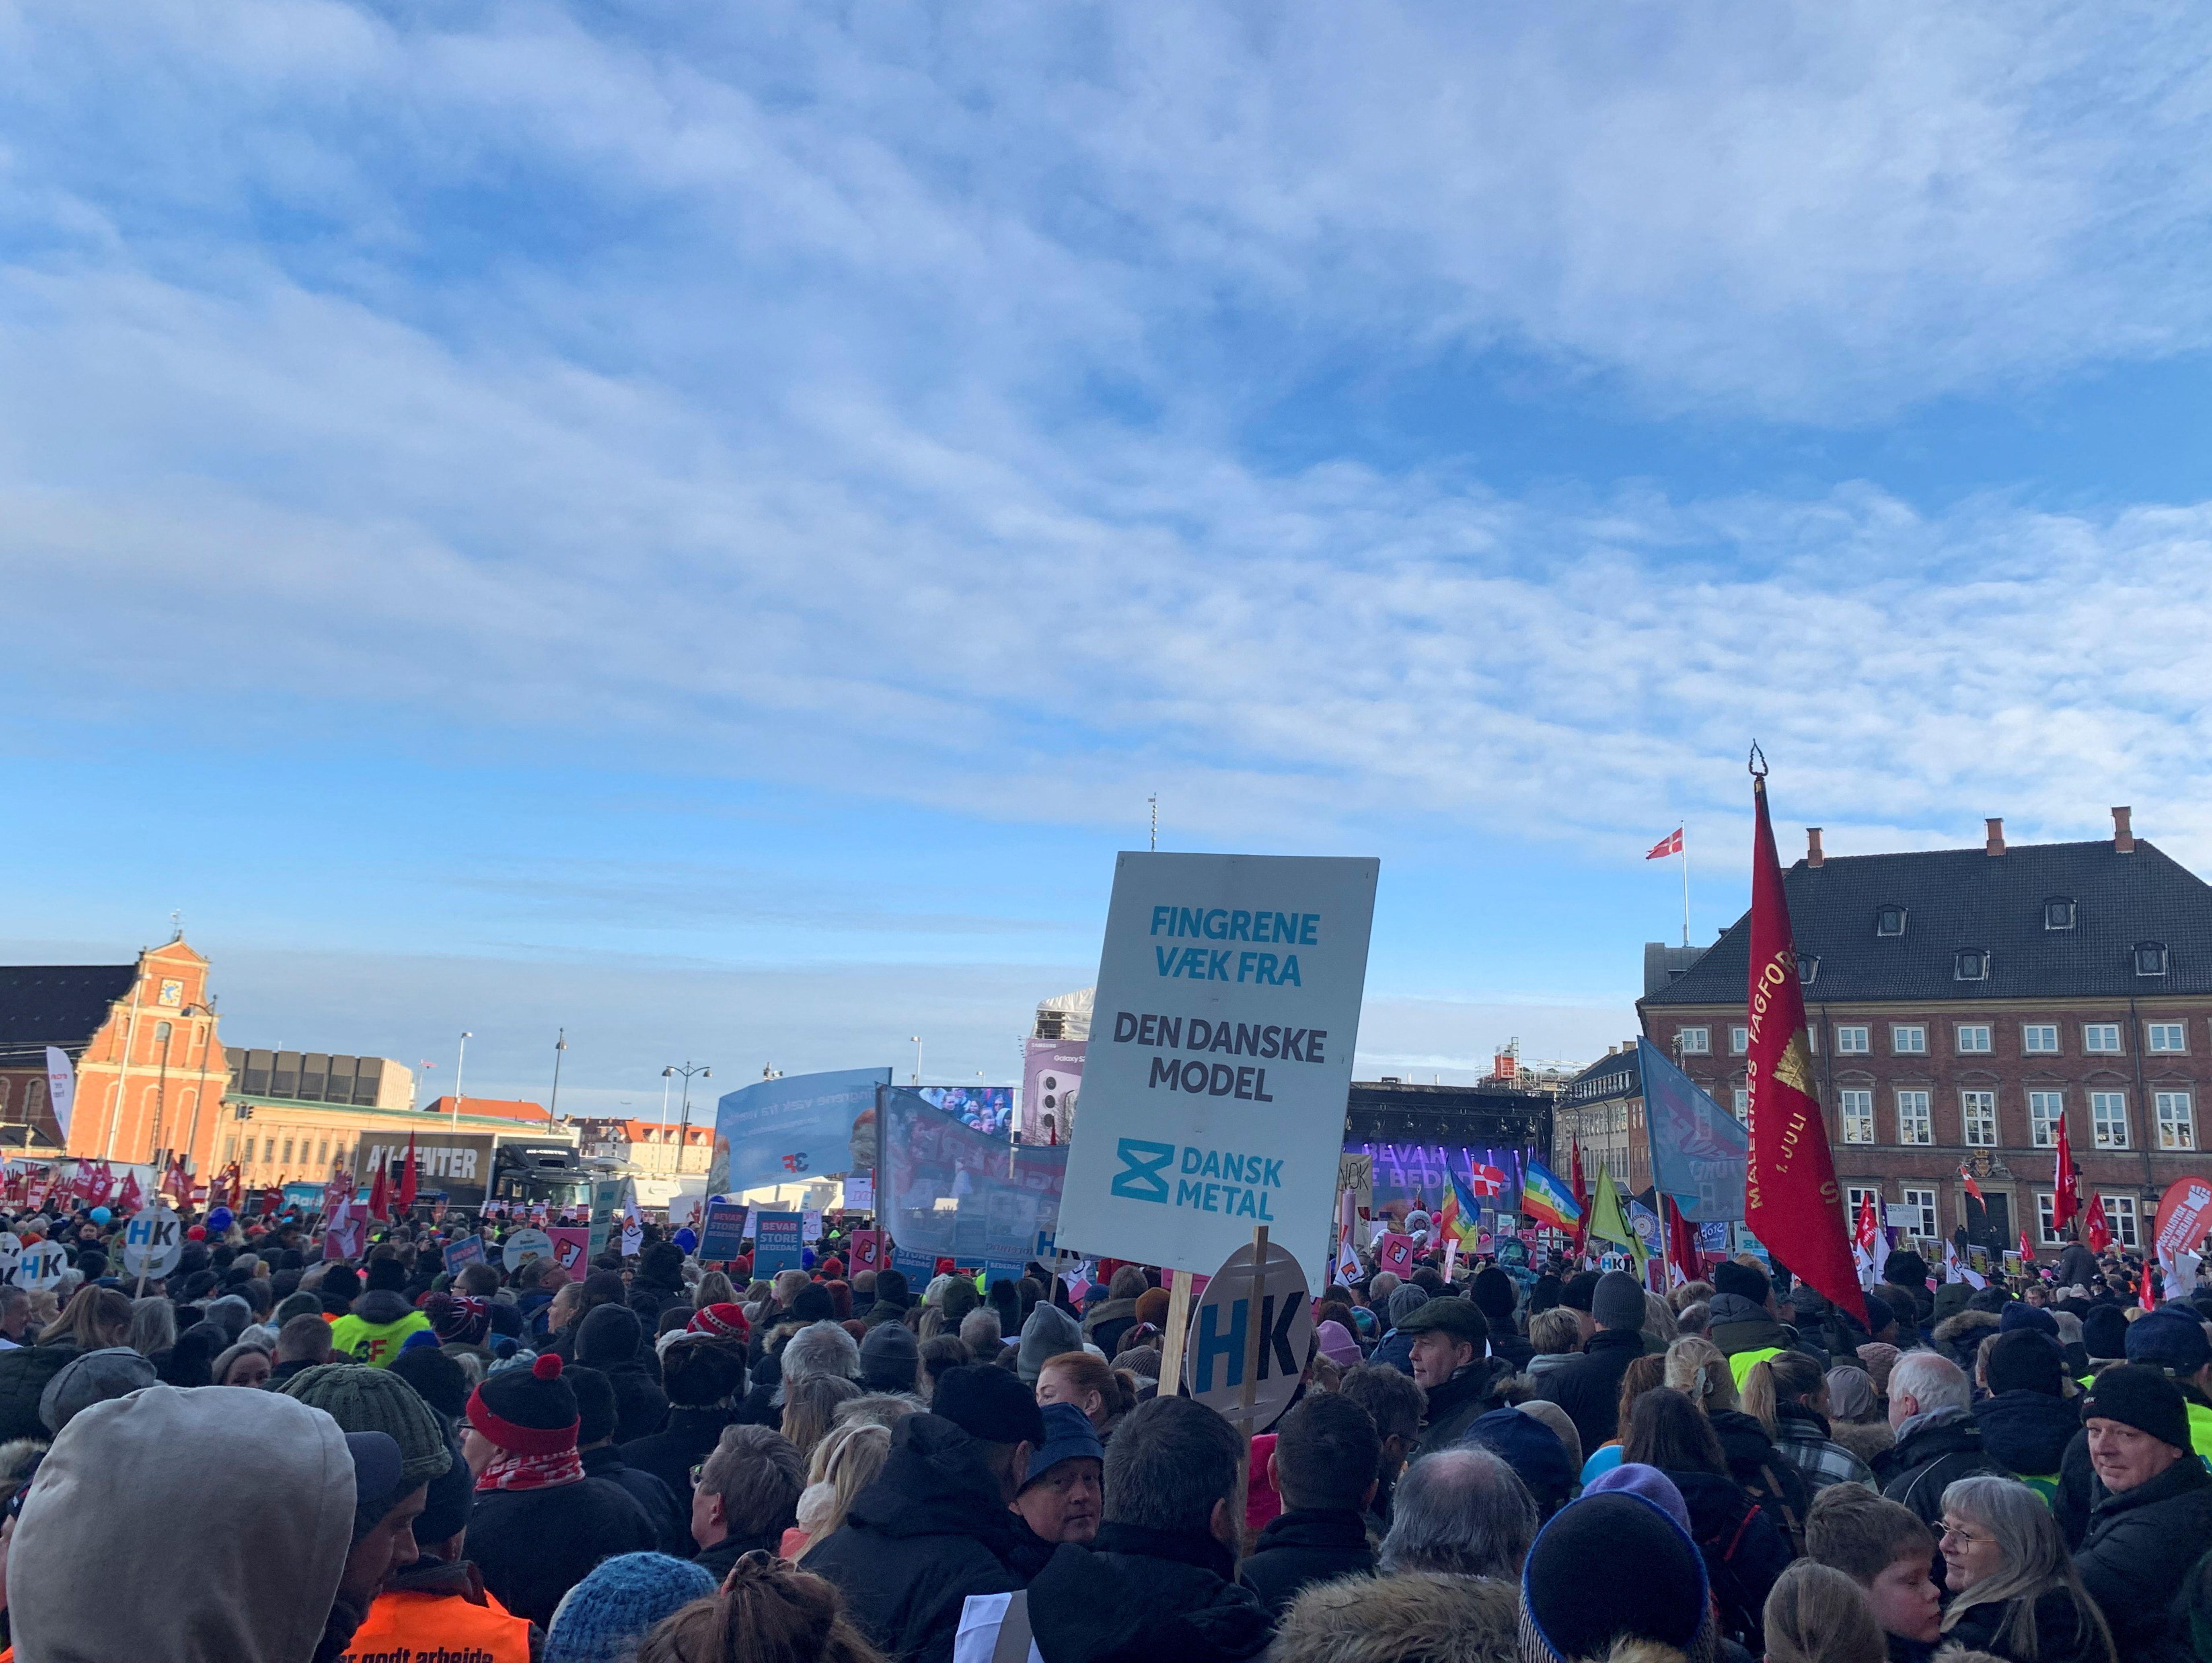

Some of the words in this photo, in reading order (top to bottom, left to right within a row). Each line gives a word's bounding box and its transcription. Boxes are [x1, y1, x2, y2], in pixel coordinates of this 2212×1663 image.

[1151, 906, 1320, 945] FINGRENE
[1155, 946, 1231, 982] VÆK
[1238, 952, 1301, 987] FRA
[1749, 938, 1797, 1044] FAGFOR
[1114, 1012, 1182, 1048] DEN
[1187, 1019, 1327, 1063] DANSKE
[1054, 1055, 1078, 1063] Galaxy
[1149, 1057, 1273, 1102] MODEL
[1781, 1112, 1806, 1159] JULI
[1361, 1143, 1447, 1164] BEVAR
[1181, 1147, 1284, 1187] DANSK
[1177, 1179, 1273, 1221] METAL
[710, 1222, 741, 1231] STORE
[713, 1213, 743, 1221] BEVAR
[762, 1223, 797, 1231] BEVAR
[128, 1220, 176, 1246] HK
[760, 1233, 797, 1243] STORE
[21, 1254, 62, 1279] HK
[896, 1258, 930, 1268] BEDEDAG
[1602, 1258, 1622, 1270] HK
[356, 1340, 387, 1363] 3F
[1195, 1291, 1304, 1394] HK
